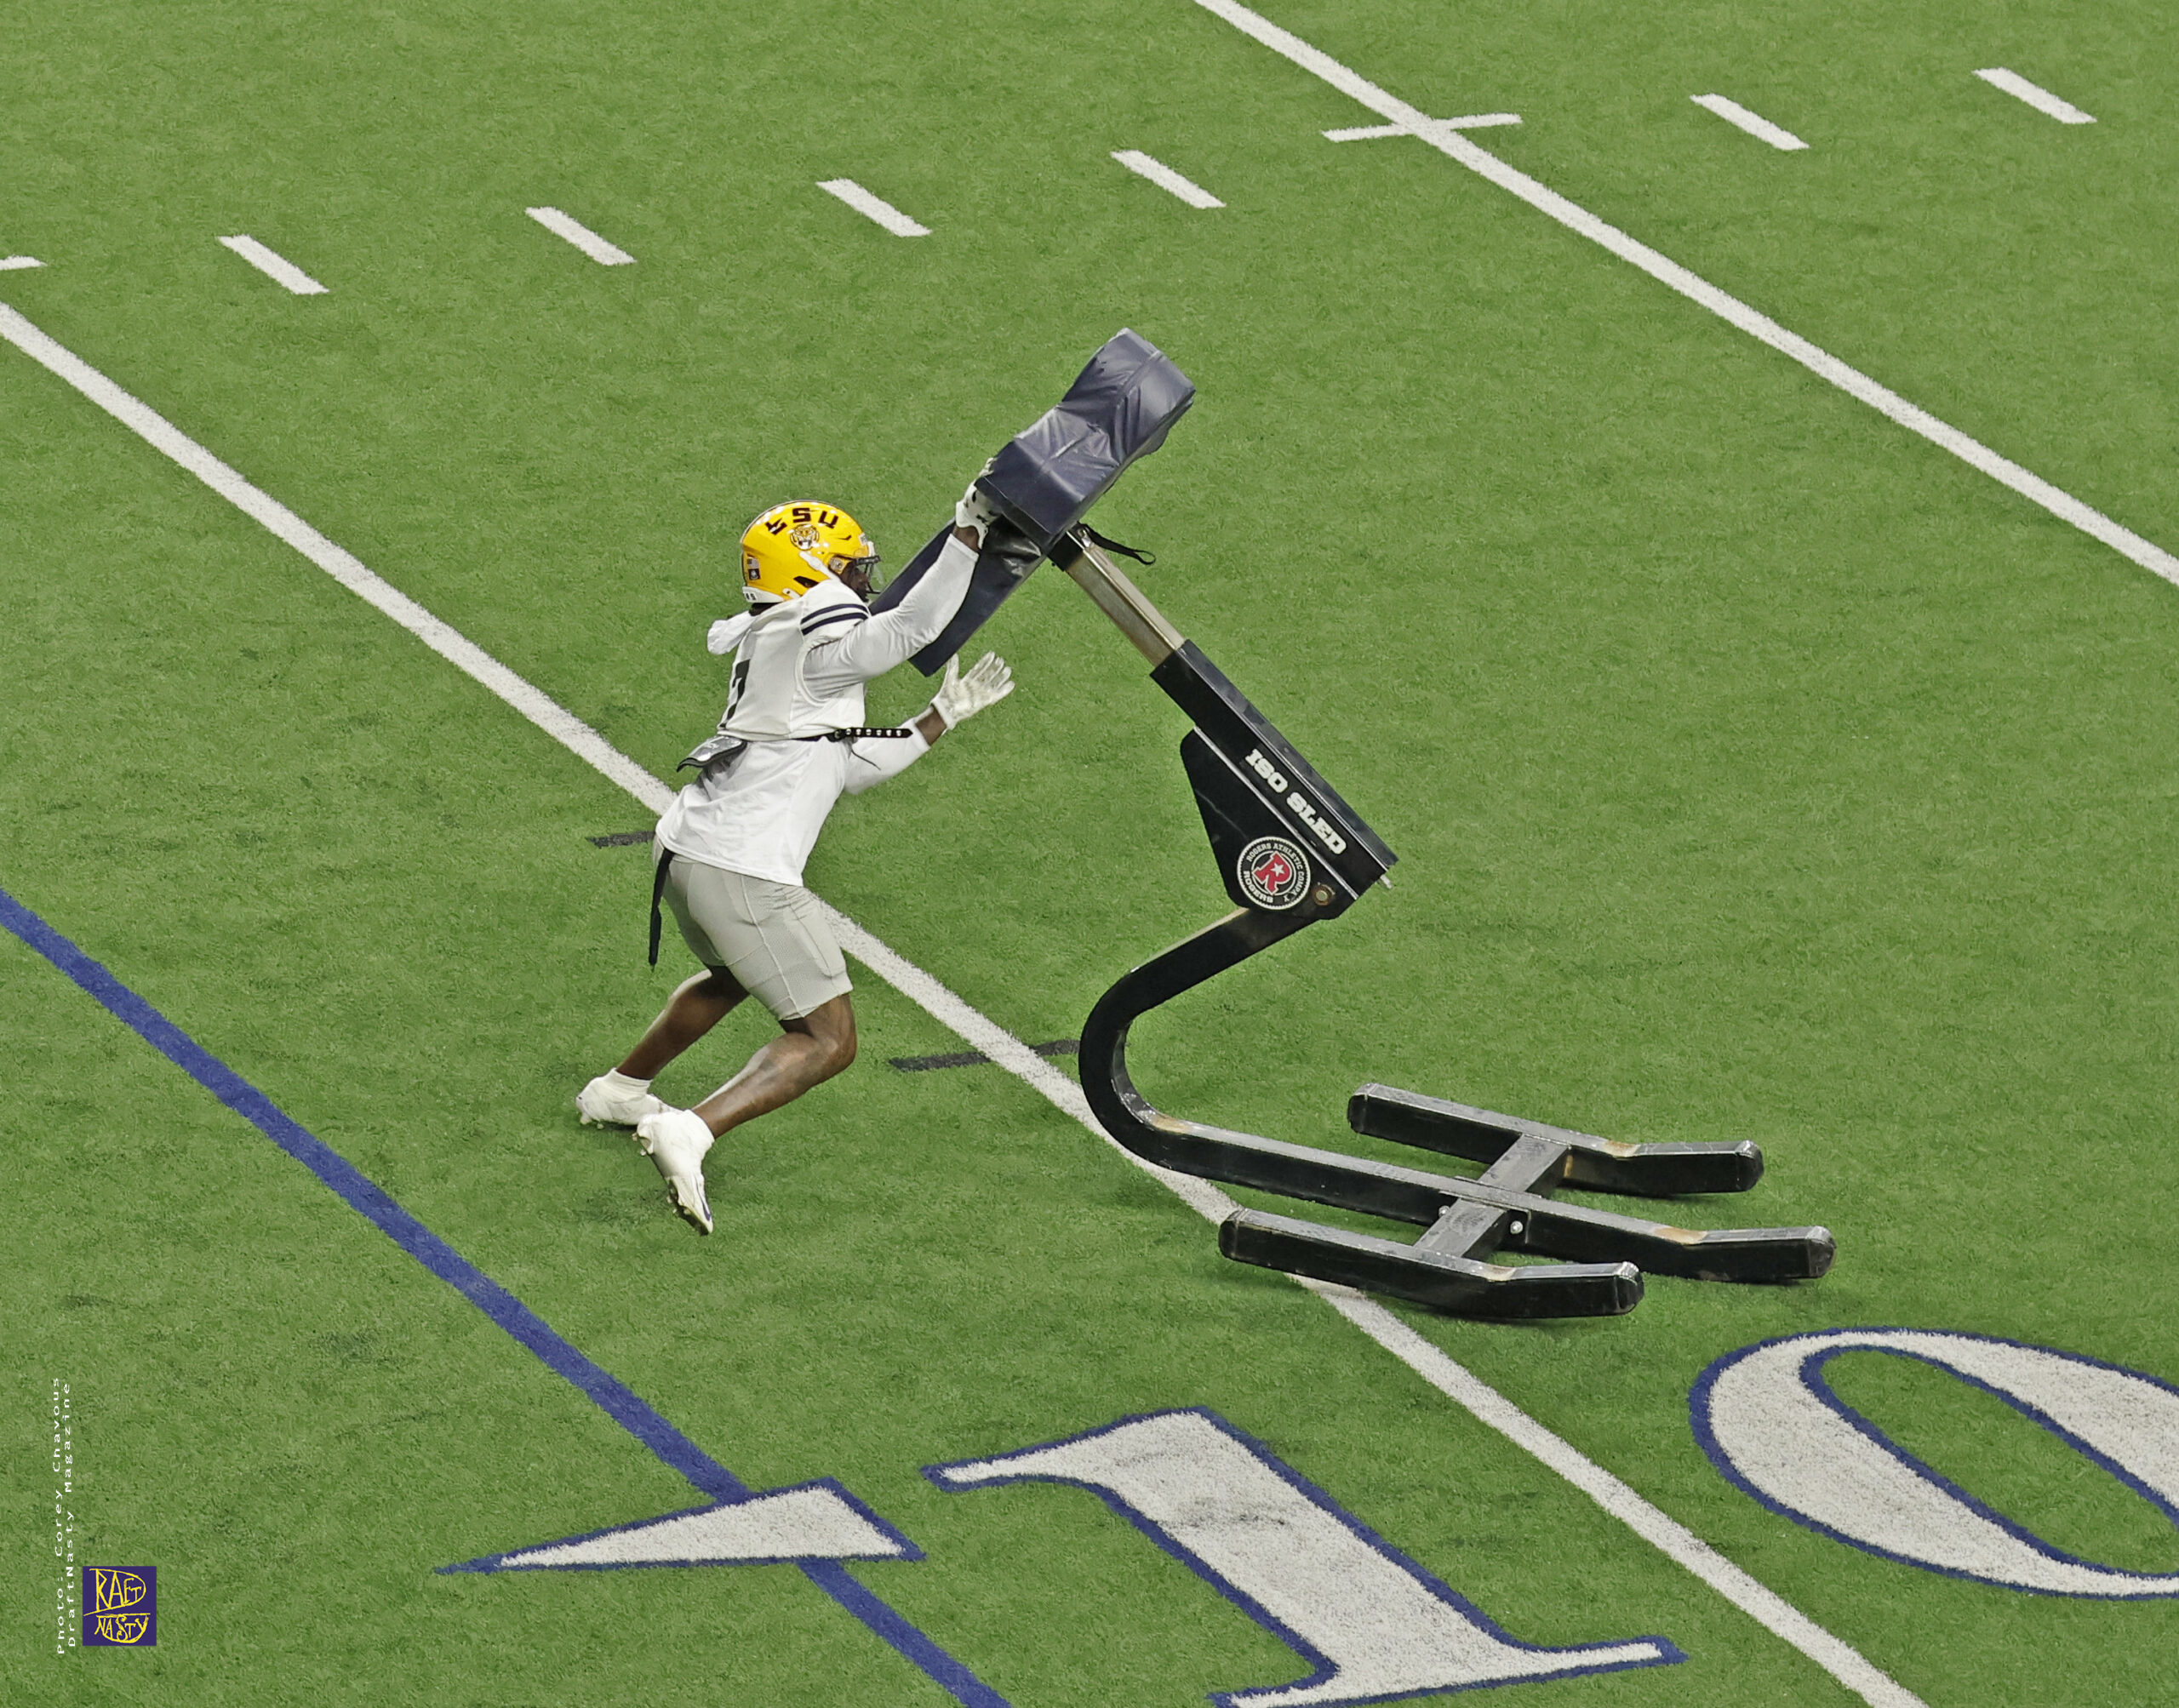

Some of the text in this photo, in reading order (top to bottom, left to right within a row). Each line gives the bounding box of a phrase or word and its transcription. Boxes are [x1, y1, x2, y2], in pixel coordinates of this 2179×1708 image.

[764, 507, 839, 535] LSU
[1244, 748, 1347, 855] ISO SLED
[1243, 871, 1274, 903] ROGERS
[1245, 843, 1305, 902] ROGERS ATHLETIC COMPAY
